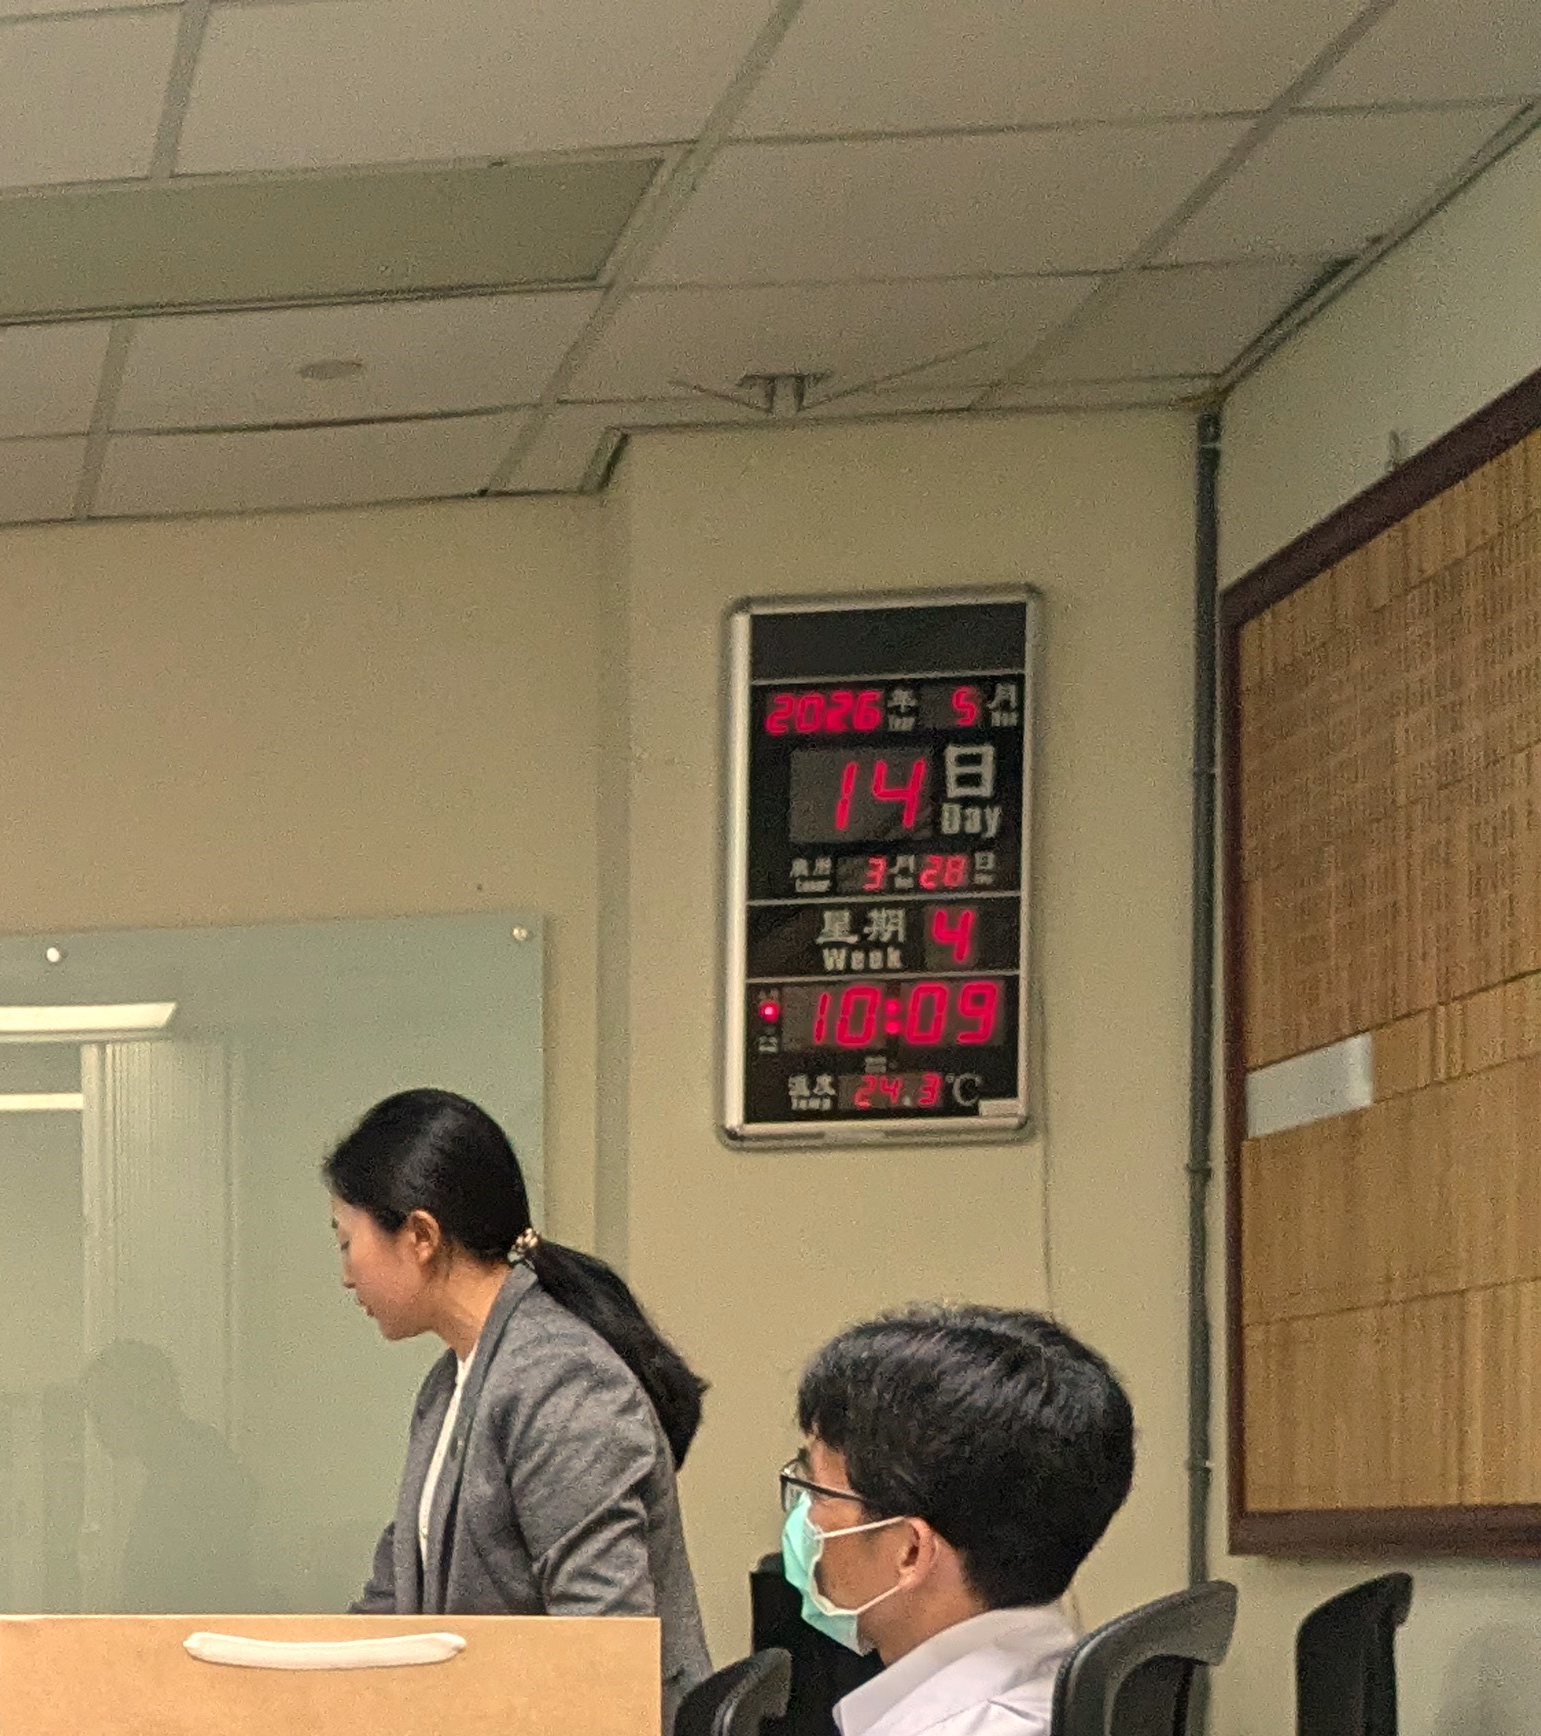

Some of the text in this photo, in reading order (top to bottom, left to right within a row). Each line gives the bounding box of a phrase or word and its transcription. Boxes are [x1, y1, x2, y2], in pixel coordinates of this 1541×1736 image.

[764, 690, 882, 736] 2026
[951, 685, 979, 727] 5
[835, 743, 996, 831] 14 日
[940, 803, 1003, 838] Day
[863, 854, 887, 892] 3
[919, 853, 966, 890] 28
[816, 907, 976, 963] 星期 4
[822, 946, 903, 971] Week
[813, 981, 1000, 1047] 10:09
